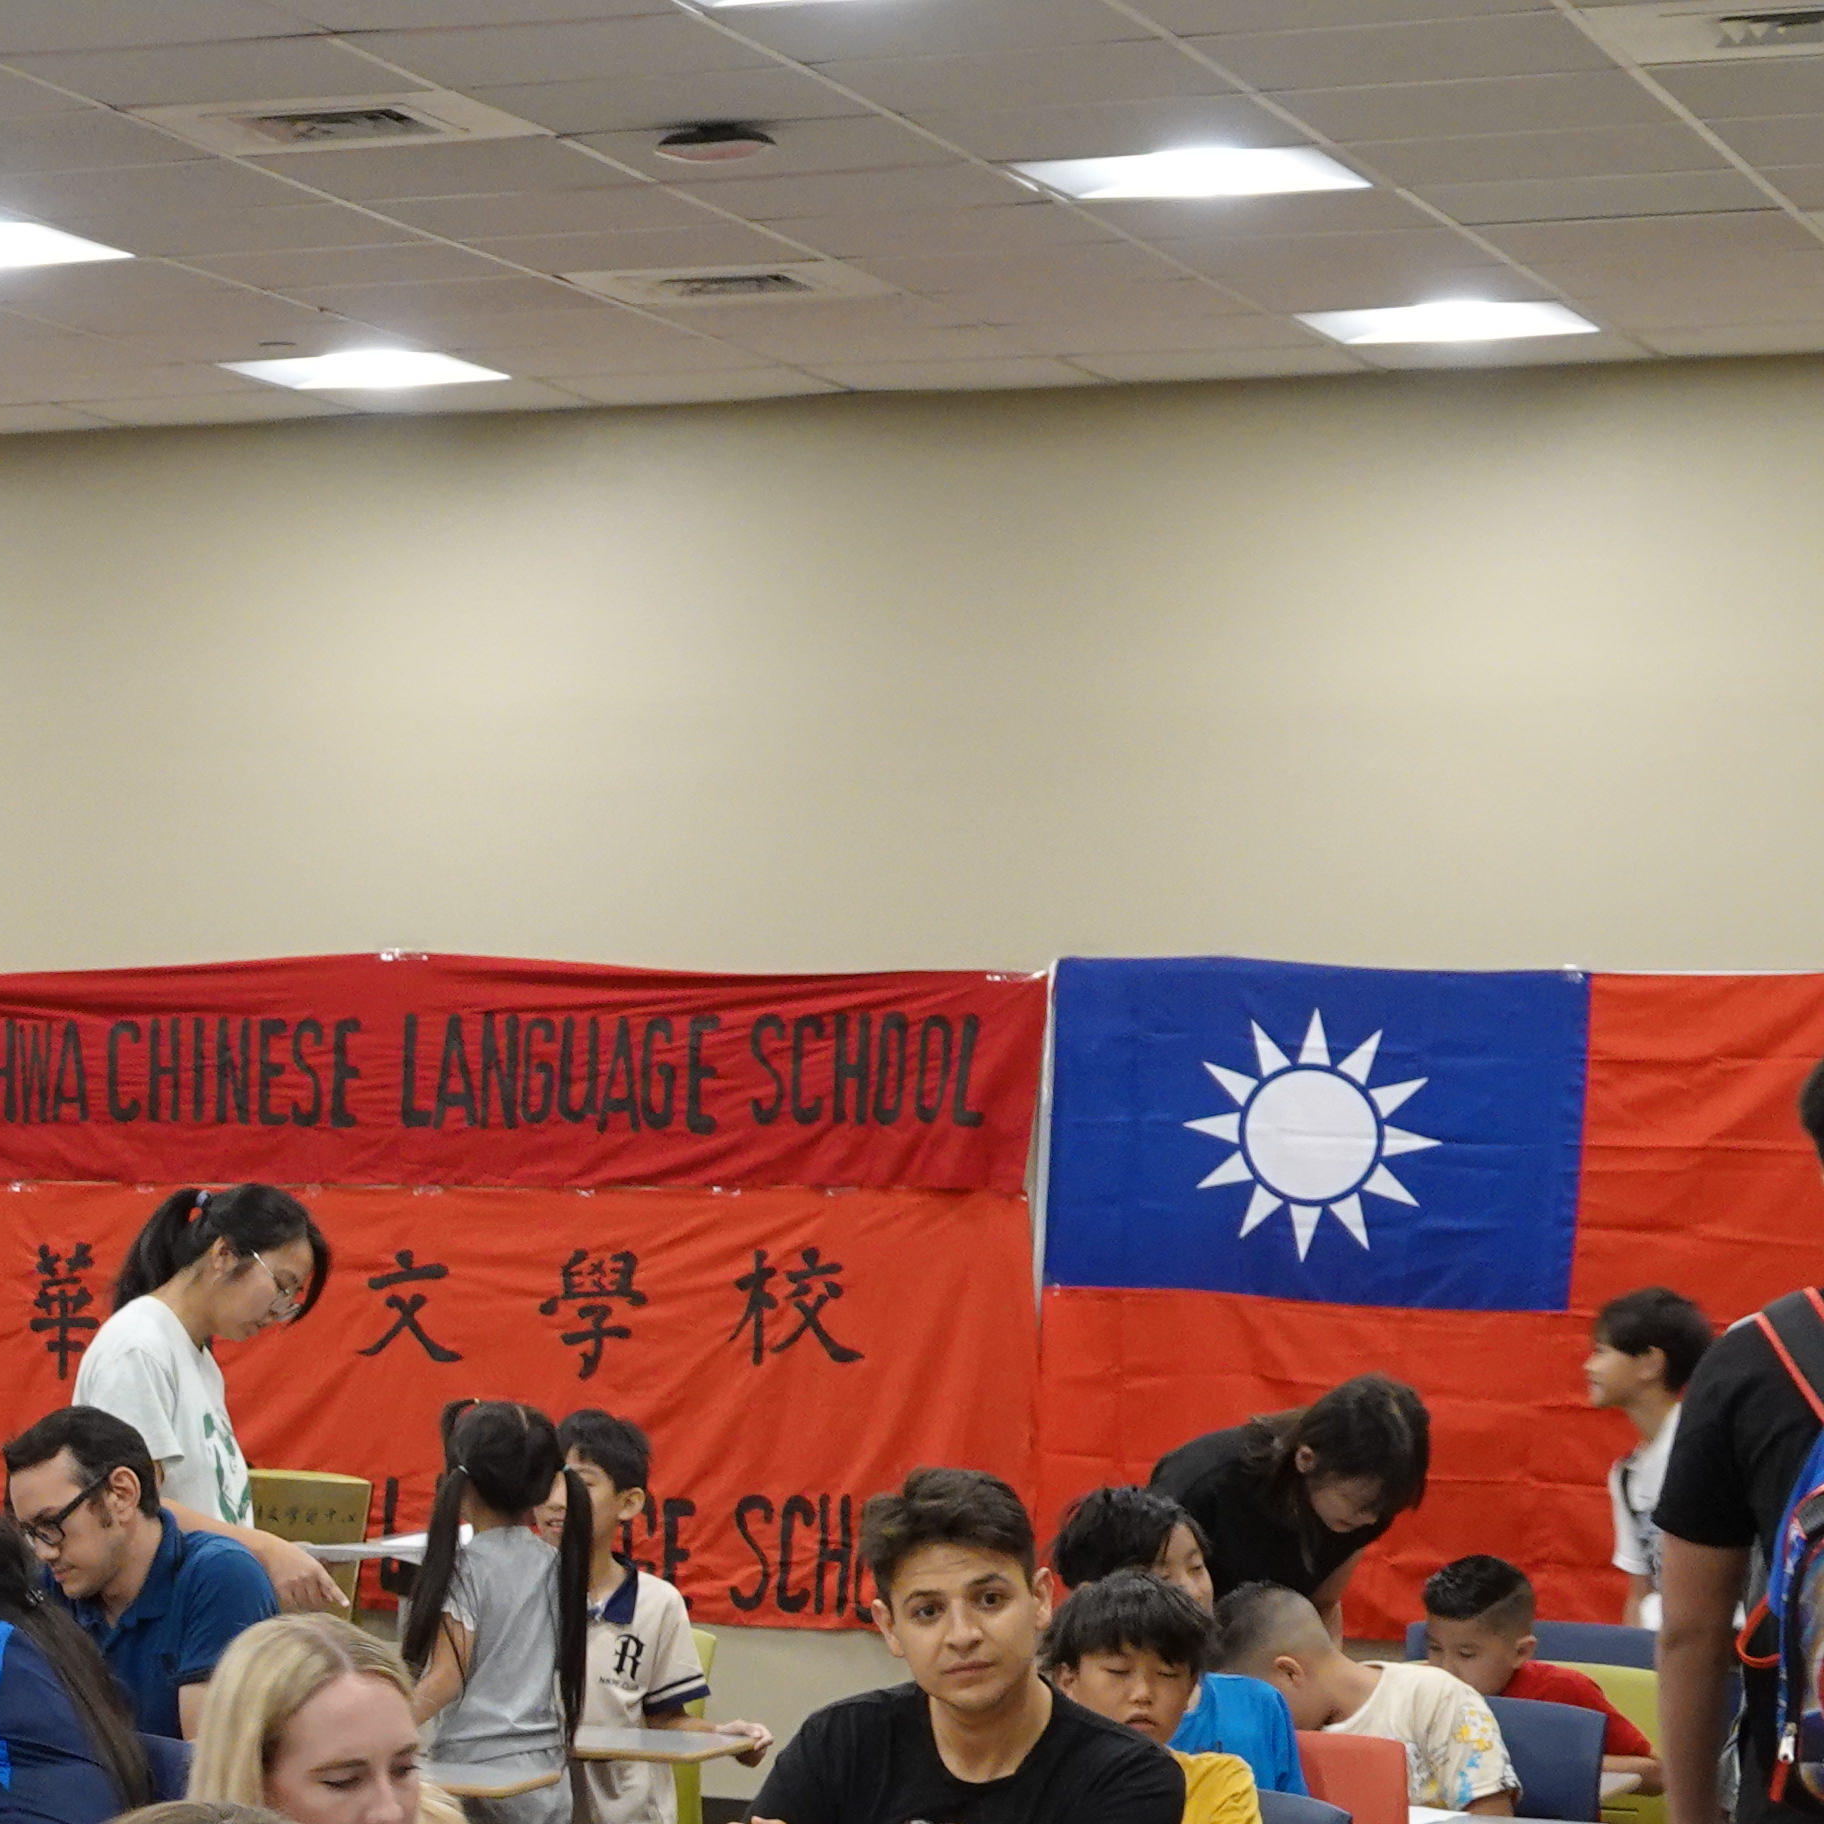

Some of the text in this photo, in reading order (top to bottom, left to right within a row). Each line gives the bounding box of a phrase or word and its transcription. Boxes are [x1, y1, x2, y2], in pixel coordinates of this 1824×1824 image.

[107, 1018, 362, 1128] CHINESE
[402, 1013, 721, 1136] LANGUAGE
[751, 1012, 984, 1128] SCHOOL
[728, 1492, 875, 1623] SCH
